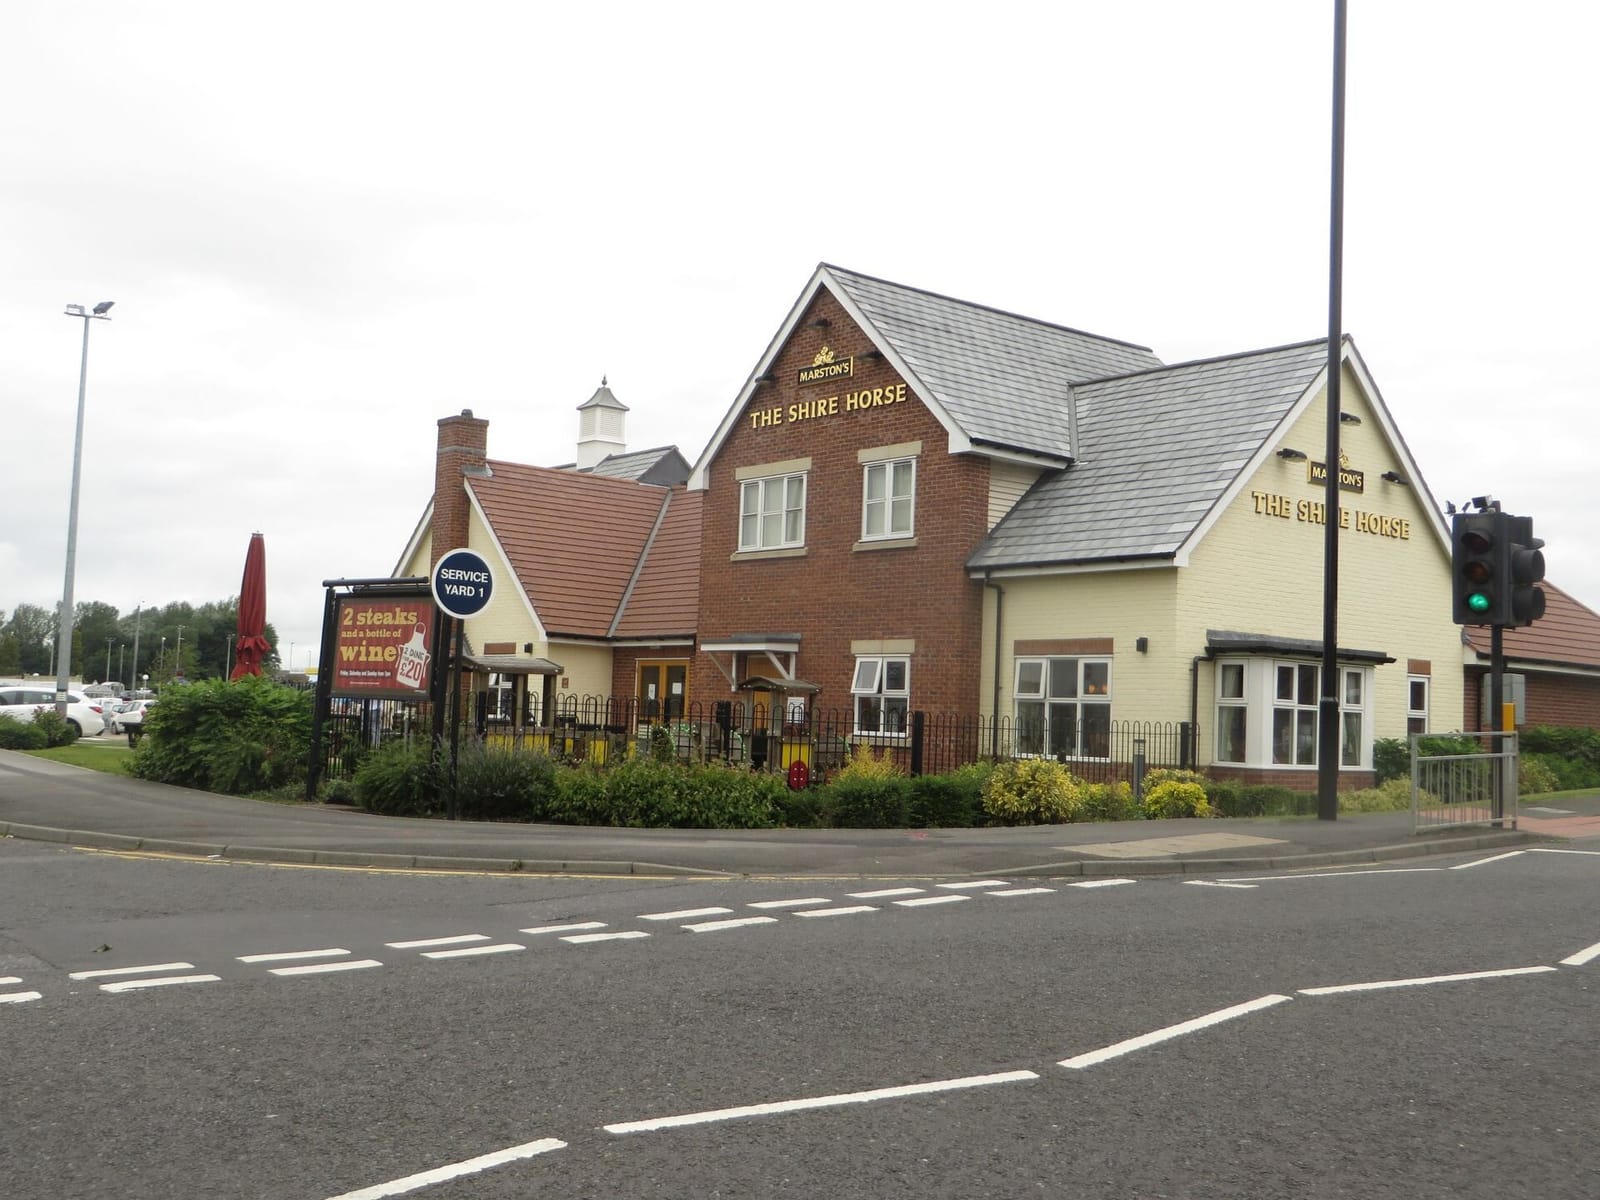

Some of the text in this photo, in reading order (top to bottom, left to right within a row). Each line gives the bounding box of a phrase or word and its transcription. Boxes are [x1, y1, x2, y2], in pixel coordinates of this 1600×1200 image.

[800, 362, 849, 382] MARSTON'S
[751, 383, 907, 429] THE SHIRE HORSE
[1312, 466, 1363, 487] MATON'S
[1252, 491, 1410, 540] THE SHIE HORSE
[441, 568, 489, 583] SERVICE
[444, 584, 484, 598] YARD 1
[343, 607, 418, 626] 2 steaks
[341, 628, 358, 638] and
[366, 628, 392, 638] bottle
[392, 628, 402, 638] of
[340, 640, 397, 662] wine
[399, 659, 422, 681] £20
